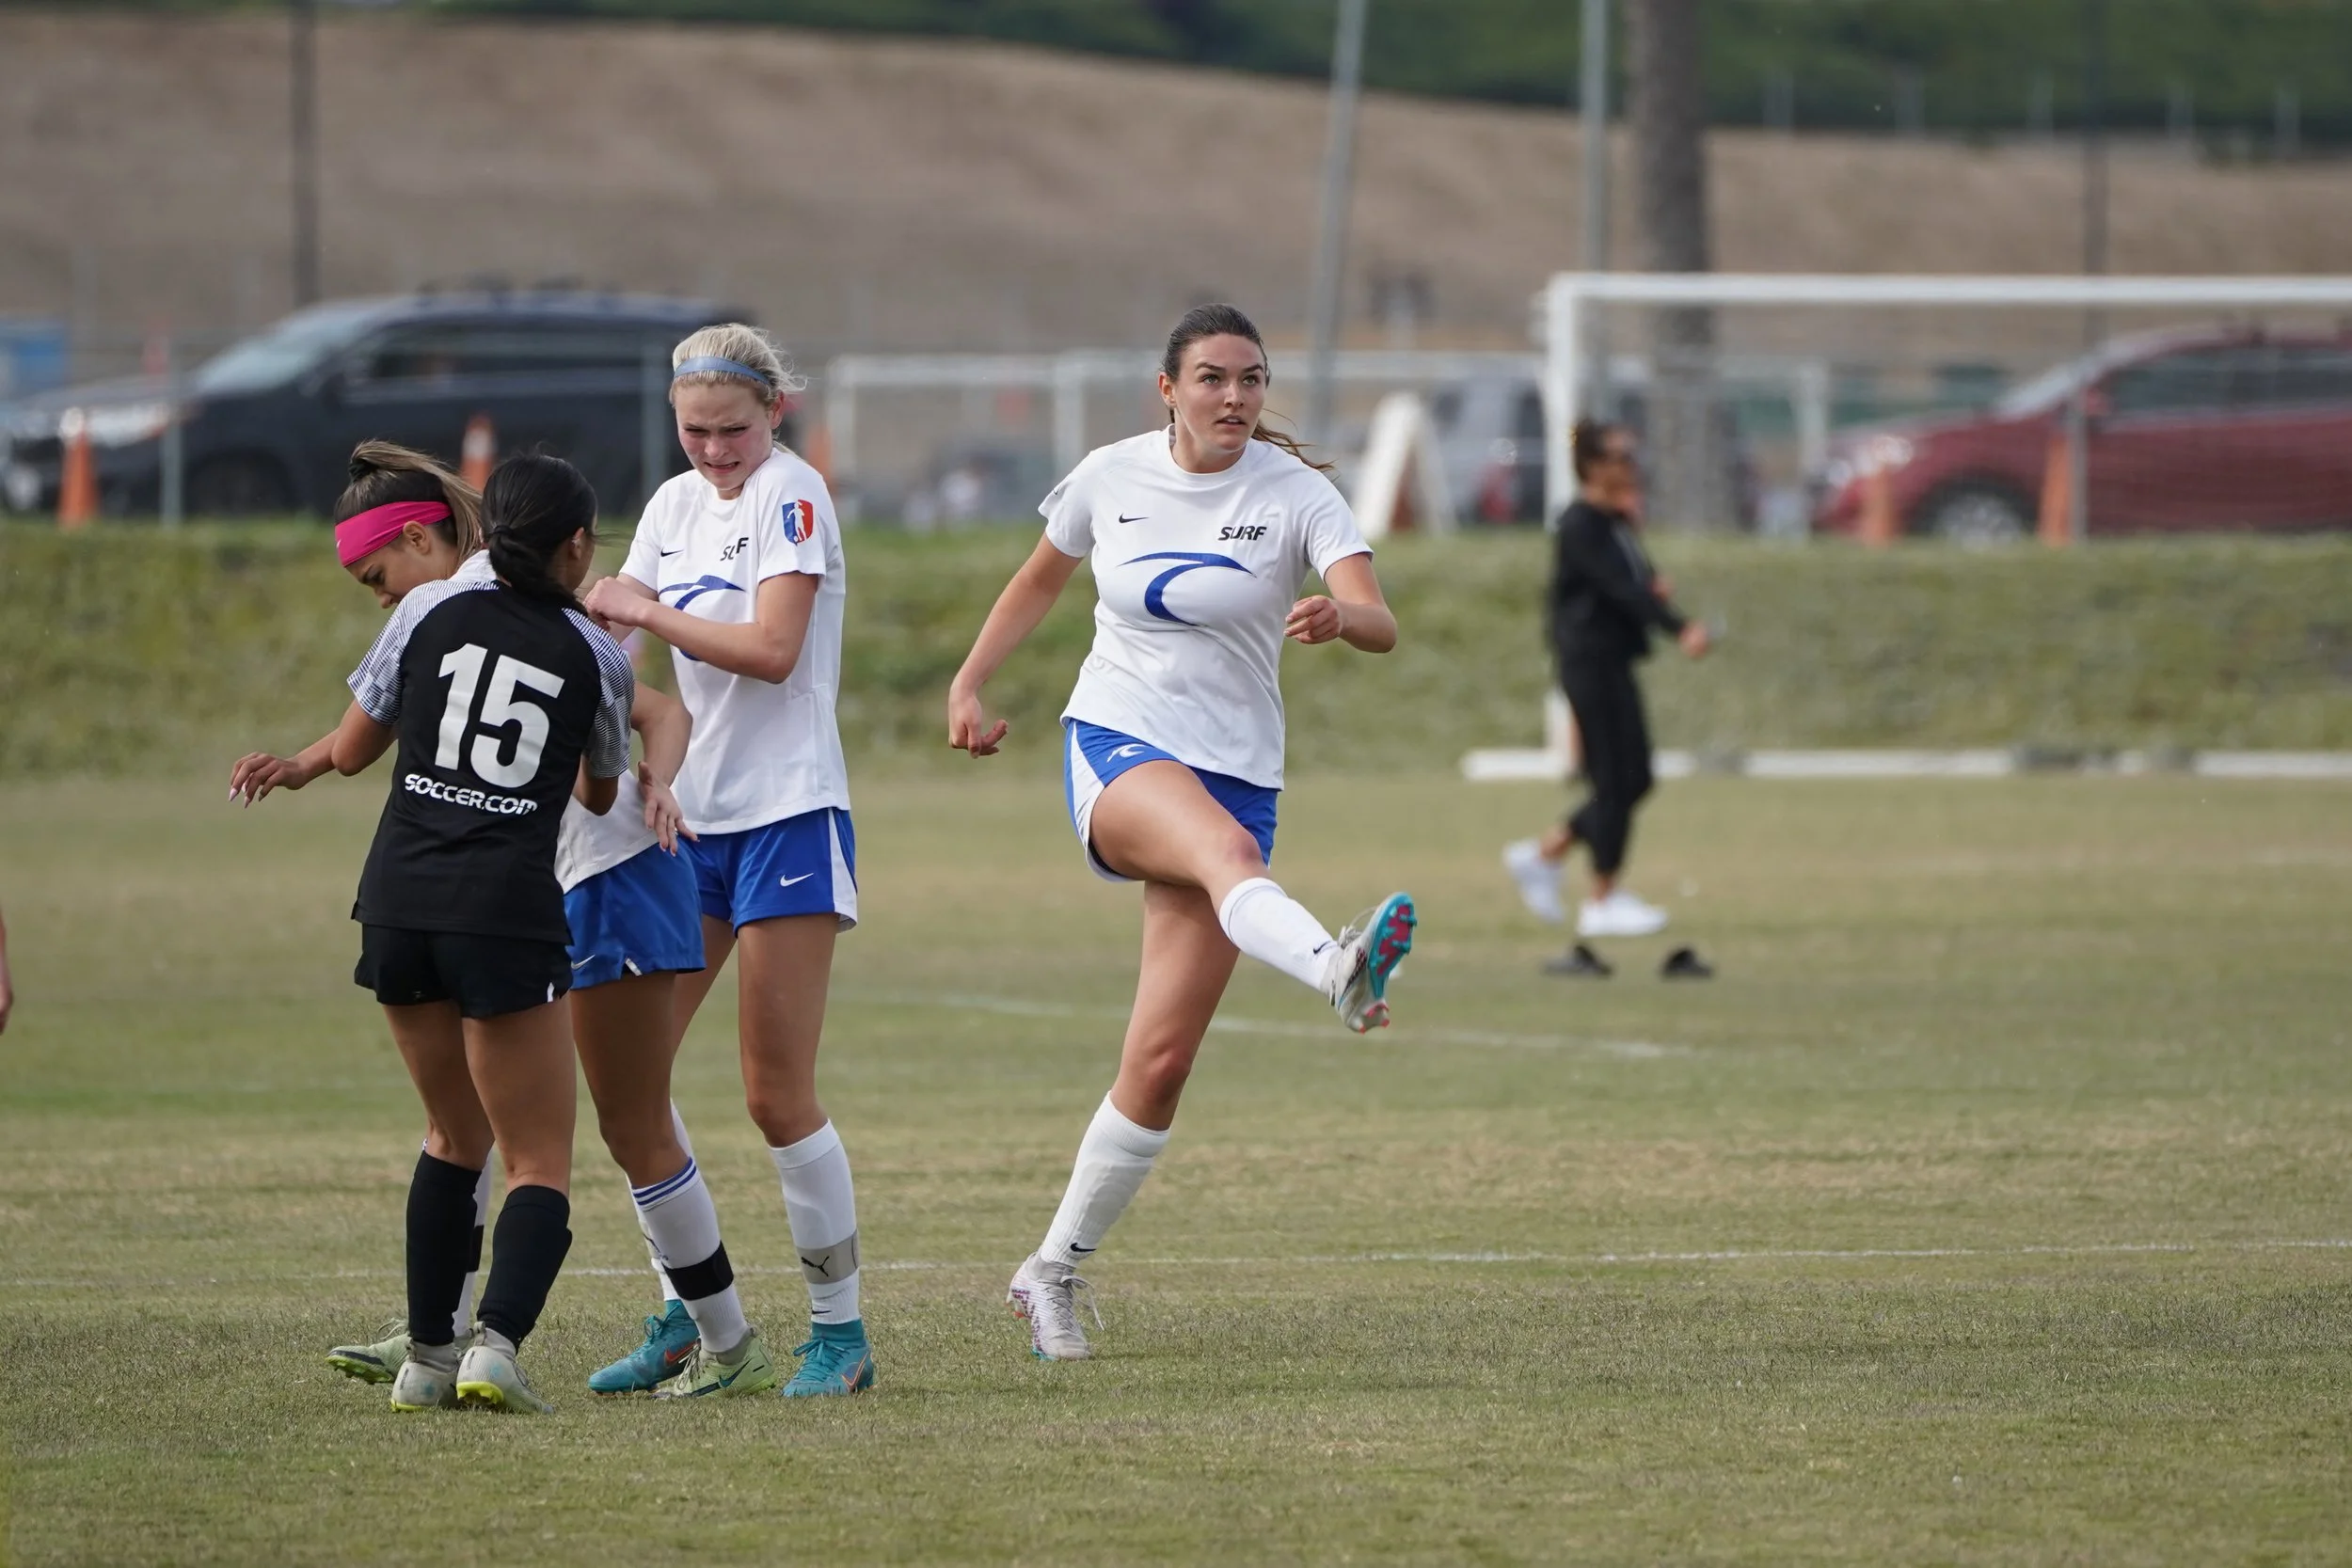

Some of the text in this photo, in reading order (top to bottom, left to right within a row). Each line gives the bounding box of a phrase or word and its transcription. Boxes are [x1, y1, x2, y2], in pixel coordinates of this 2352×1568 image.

[1217, 526, 1267, 541] SURF
[435, 642, 565, 788] 15
[405, 773, 538, 816] SOCCER.COM
